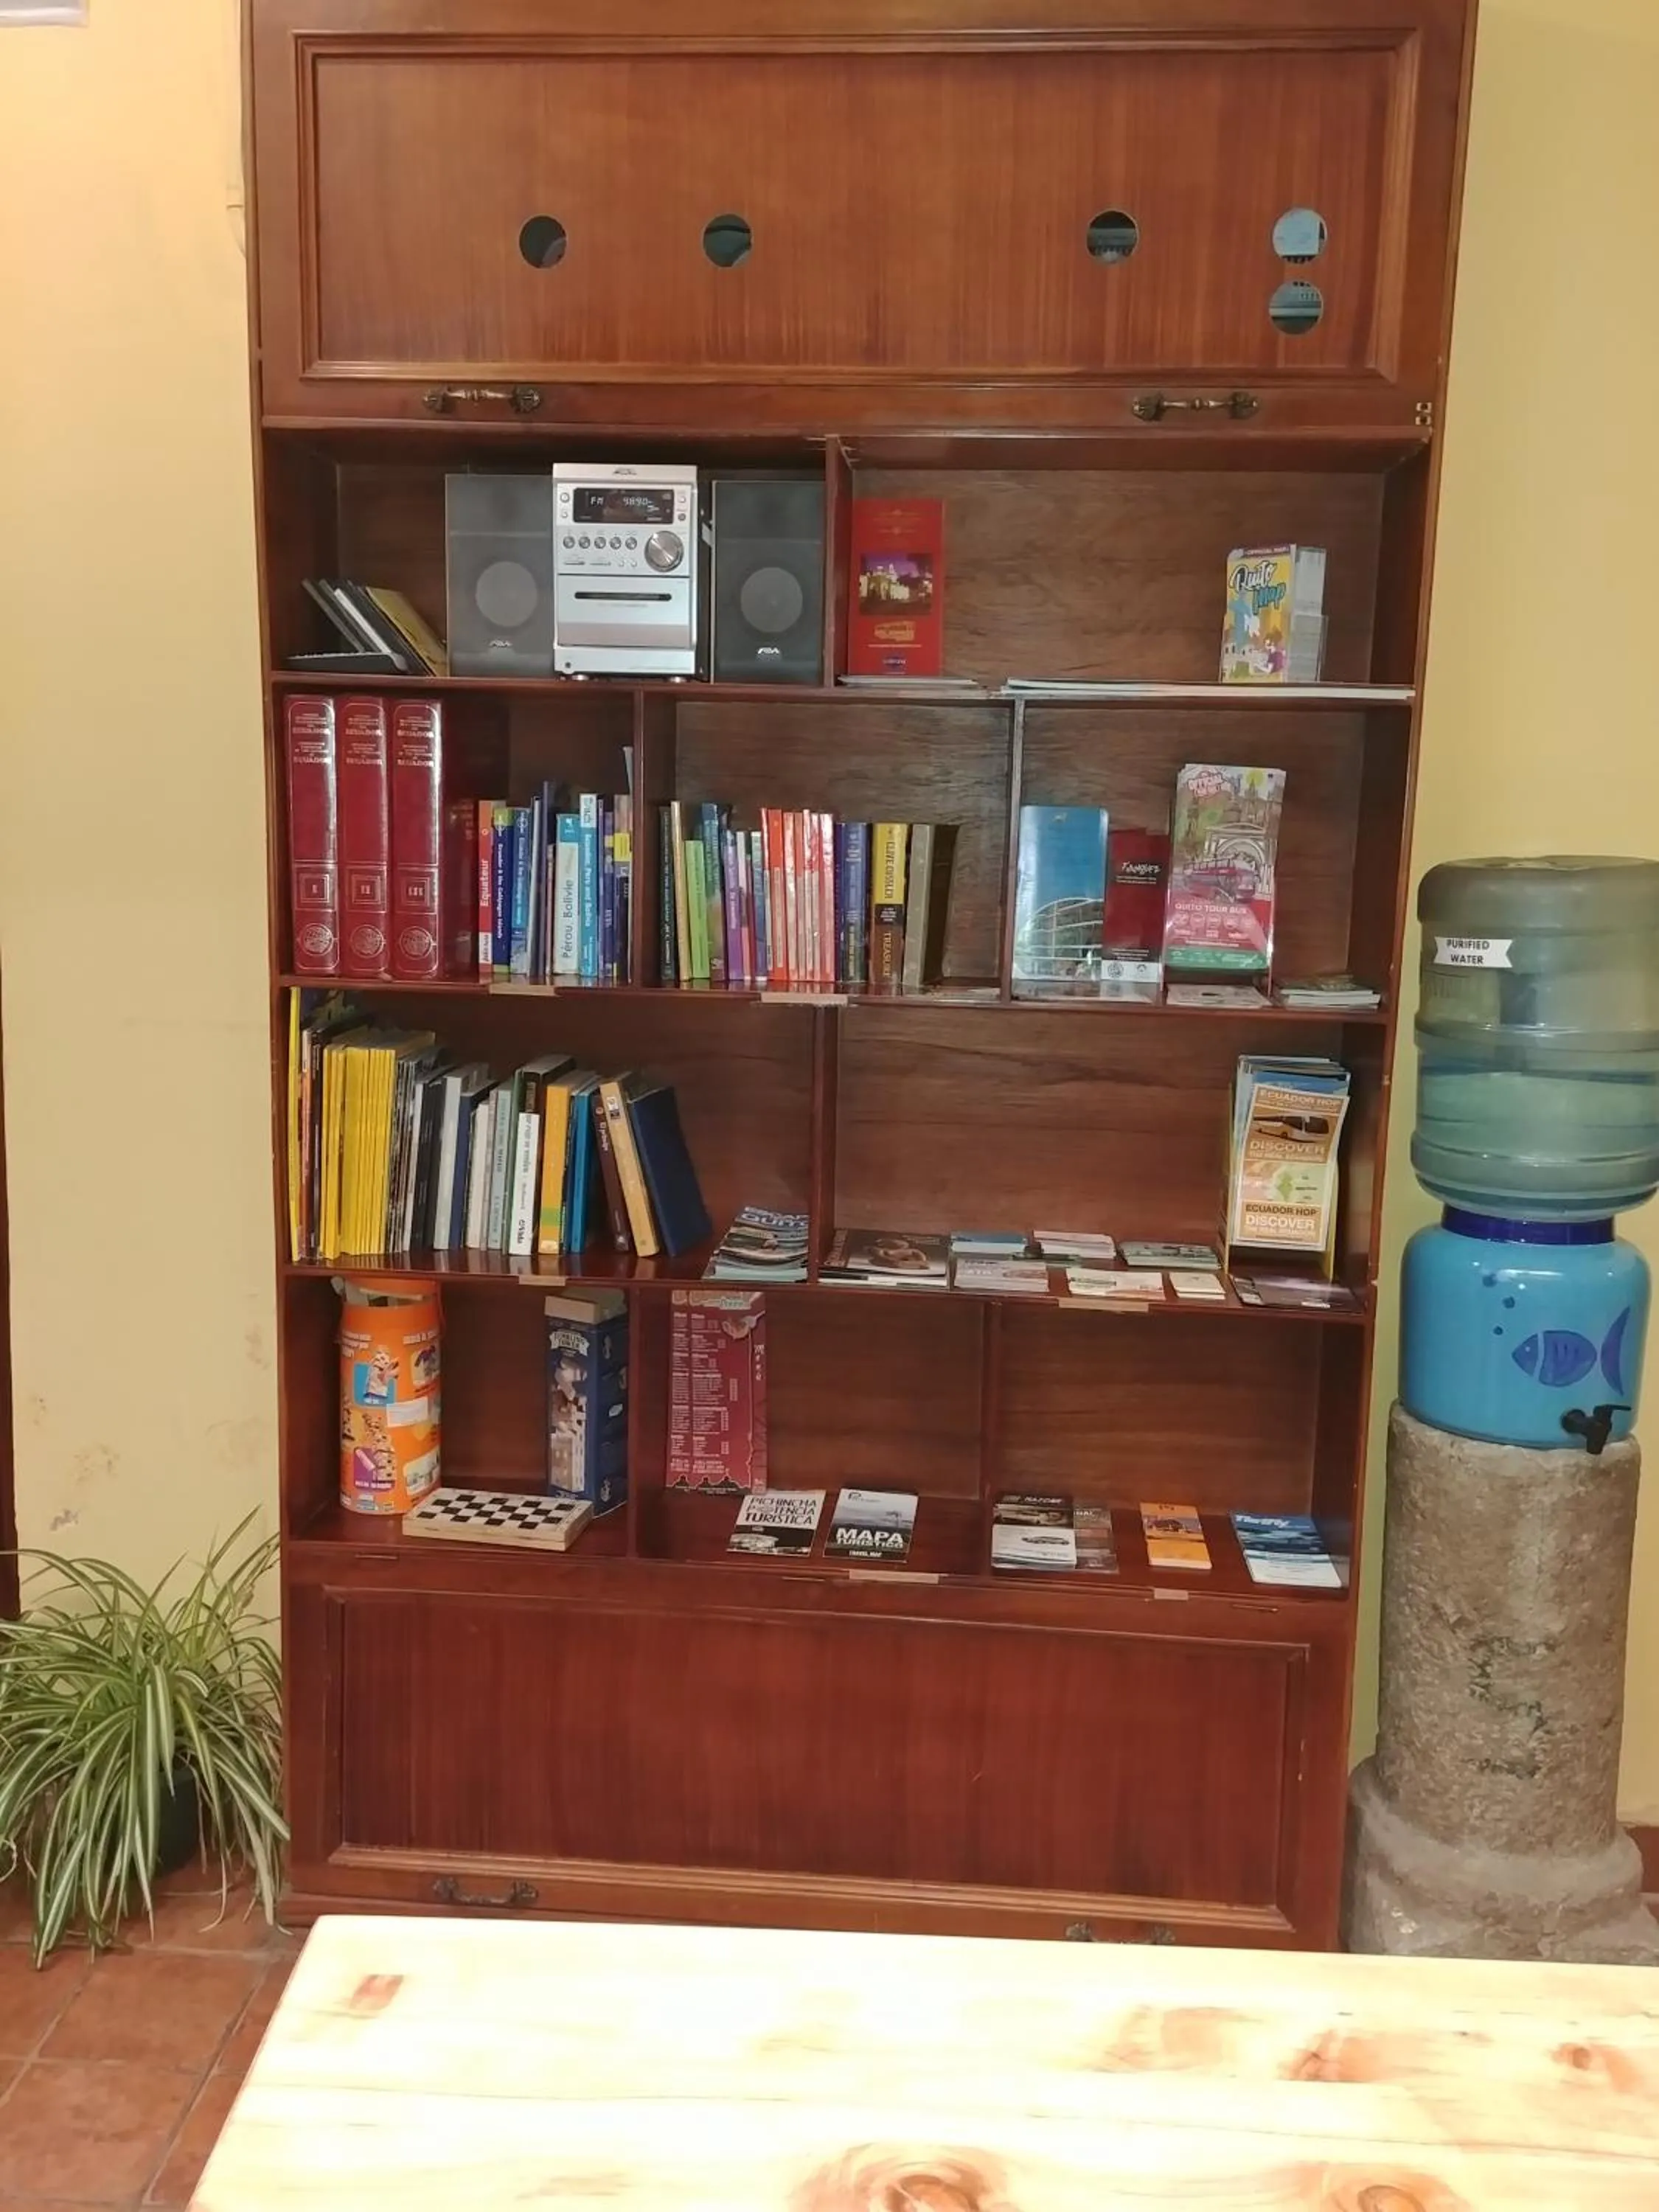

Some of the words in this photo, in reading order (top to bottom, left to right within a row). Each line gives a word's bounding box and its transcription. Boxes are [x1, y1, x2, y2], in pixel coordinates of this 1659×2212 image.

[1229, 560, 1278, 592] Quito
[1252, 582, 1287, 616] Map
[480, 858, 491, 908] Equateur
[563, 879, 574, 919] Bolivie
[1446, 939, 1490, 950] PURIFIED
[1450, 953, 1484, 965] WATER
[1245, 1204, 1293, 1215] ECUADOR
[1295, 1208, 1317, 1217] HOP
[751, 1498, 816, 1506] PICHINCHA
[835, 1527, 904, 1547] MAPA
